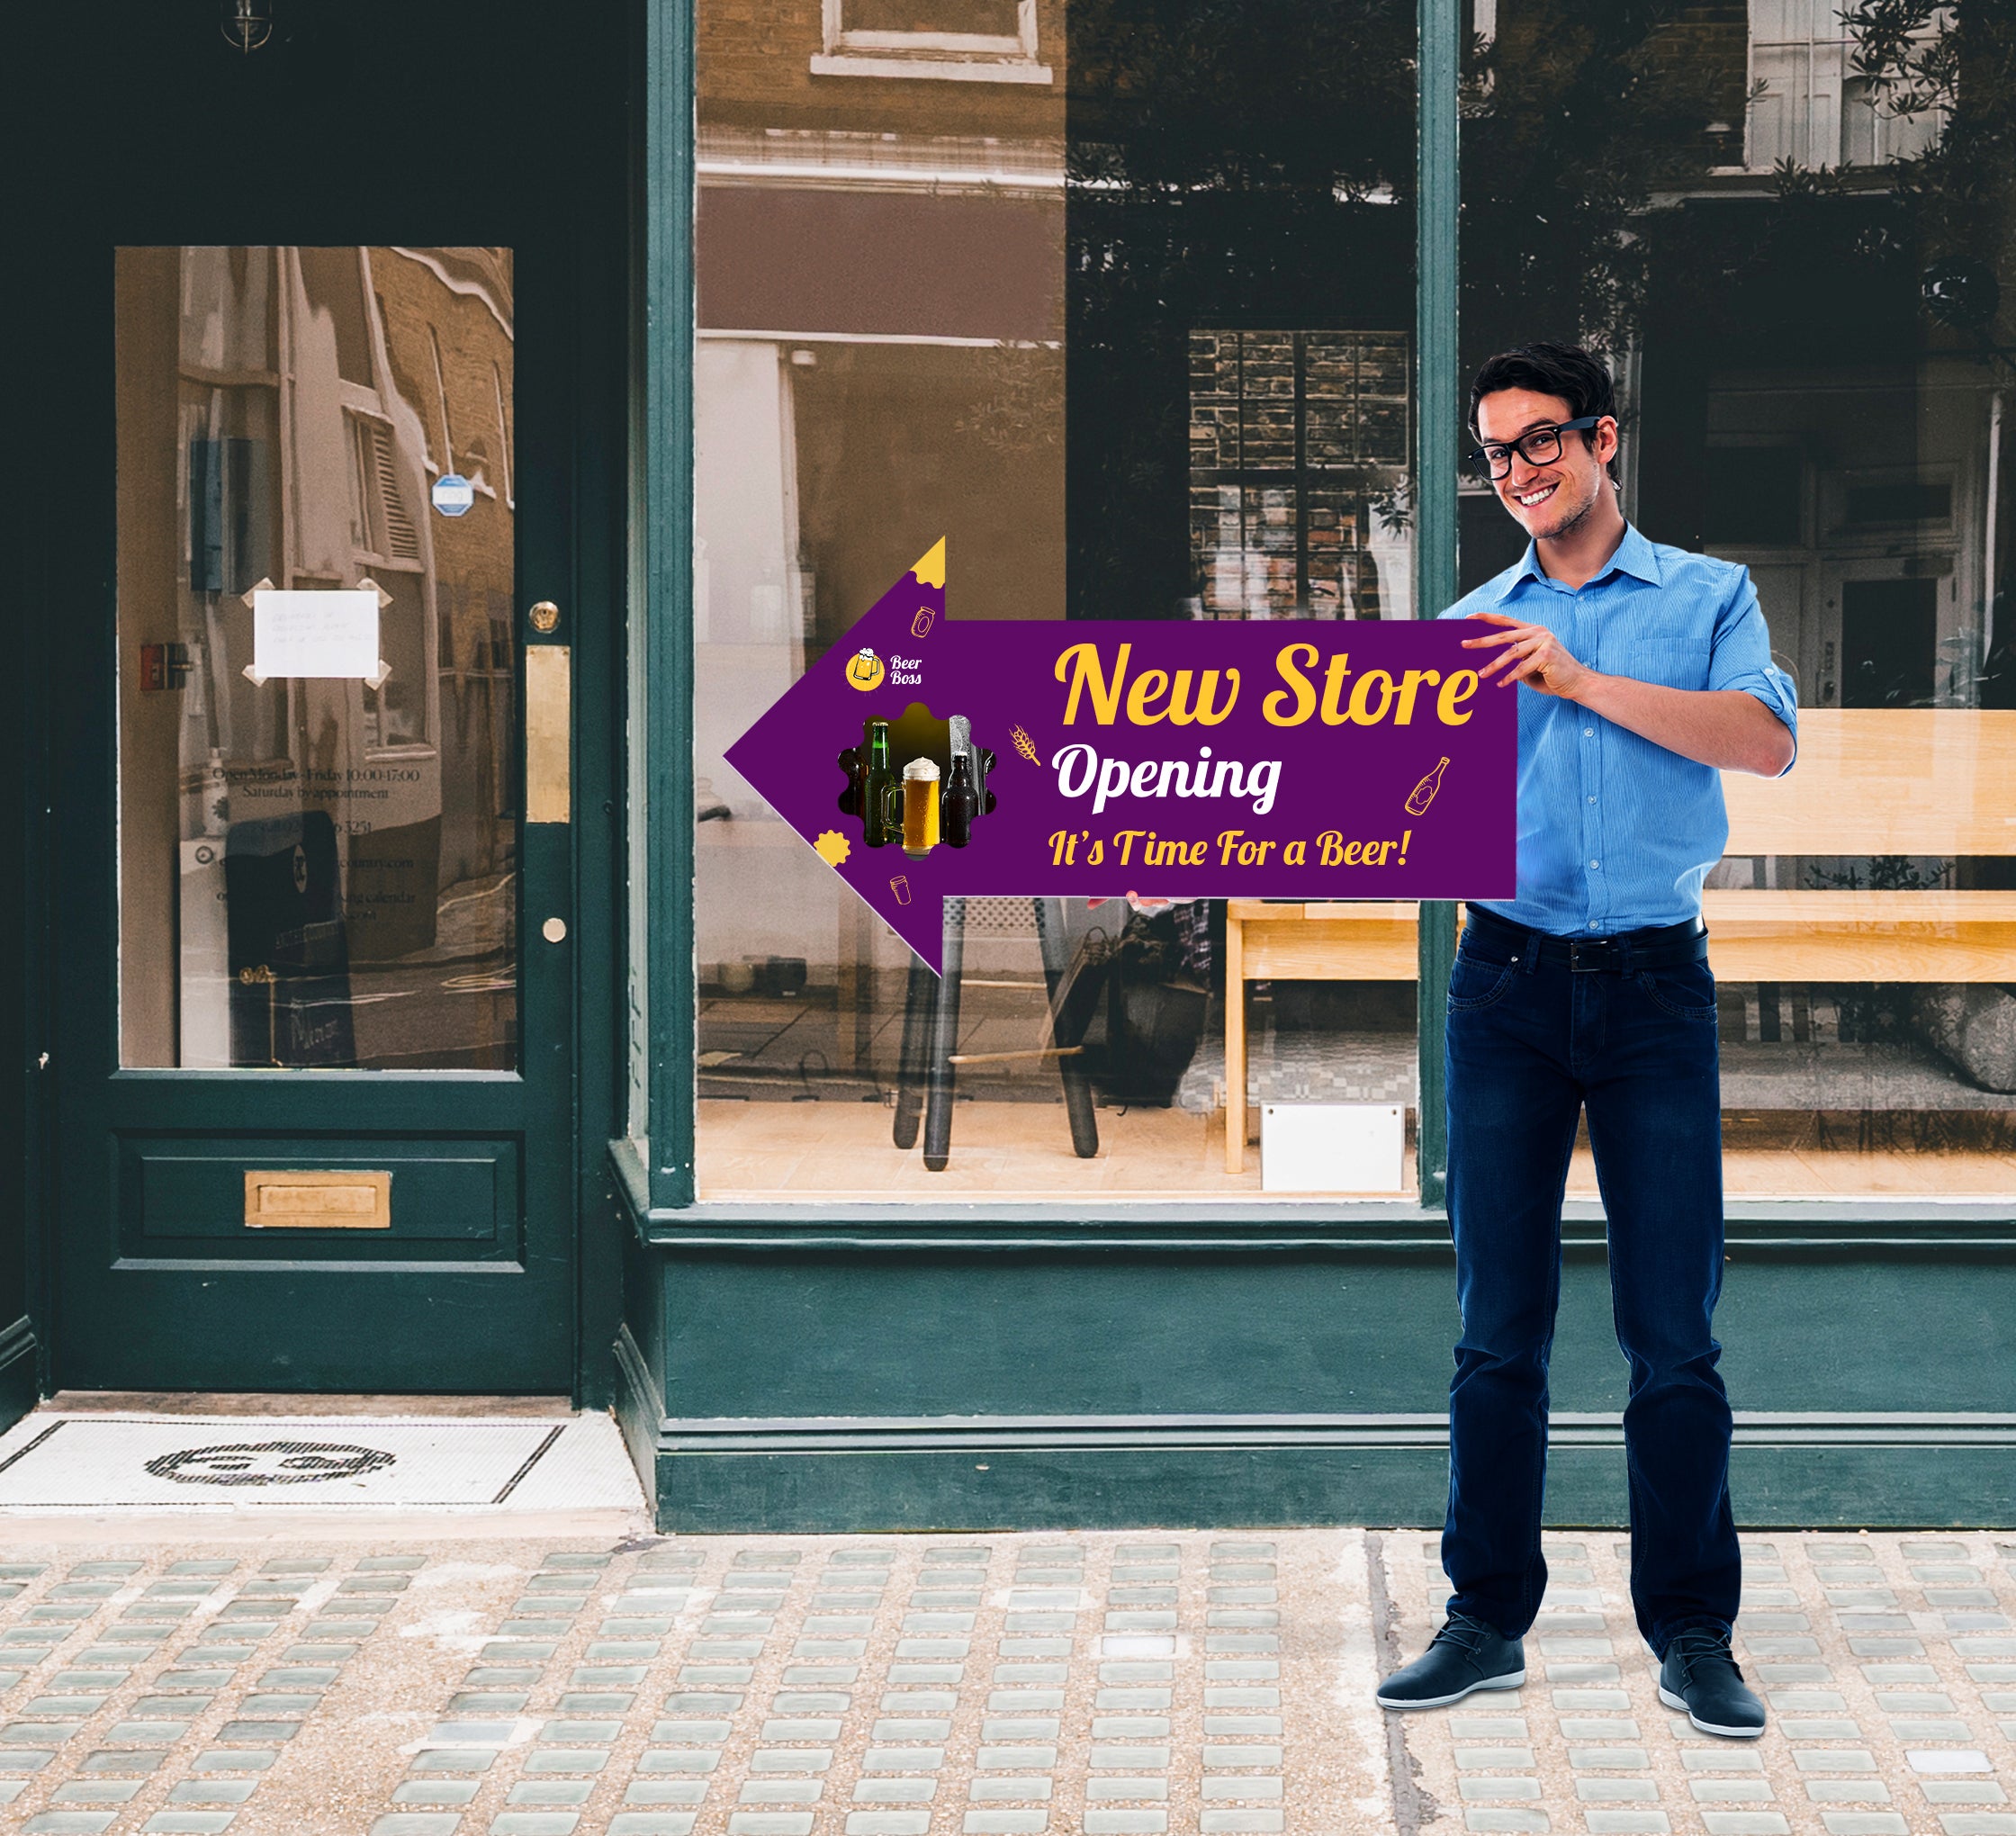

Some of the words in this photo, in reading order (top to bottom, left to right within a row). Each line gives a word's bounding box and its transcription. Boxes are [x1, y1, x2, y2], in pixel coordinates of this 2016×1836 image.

[889, 654, 922, 670] Beer
[889, 670, 922, 685] Boss
[1054, 643, 1241, 725] New
[1262, 643, 1479, 726] Store
[1051, 743, 1282, 814] Opening
[243, 787, 293, 799] Saturday
[1048, 830, 1104, 866] It's
[1112, 830, 1208, 866] Time
[1216, 830, 1276, 866] For
[1282, 841, 1307, 866] a
[1316, 830, 1412, 866] Beer!
